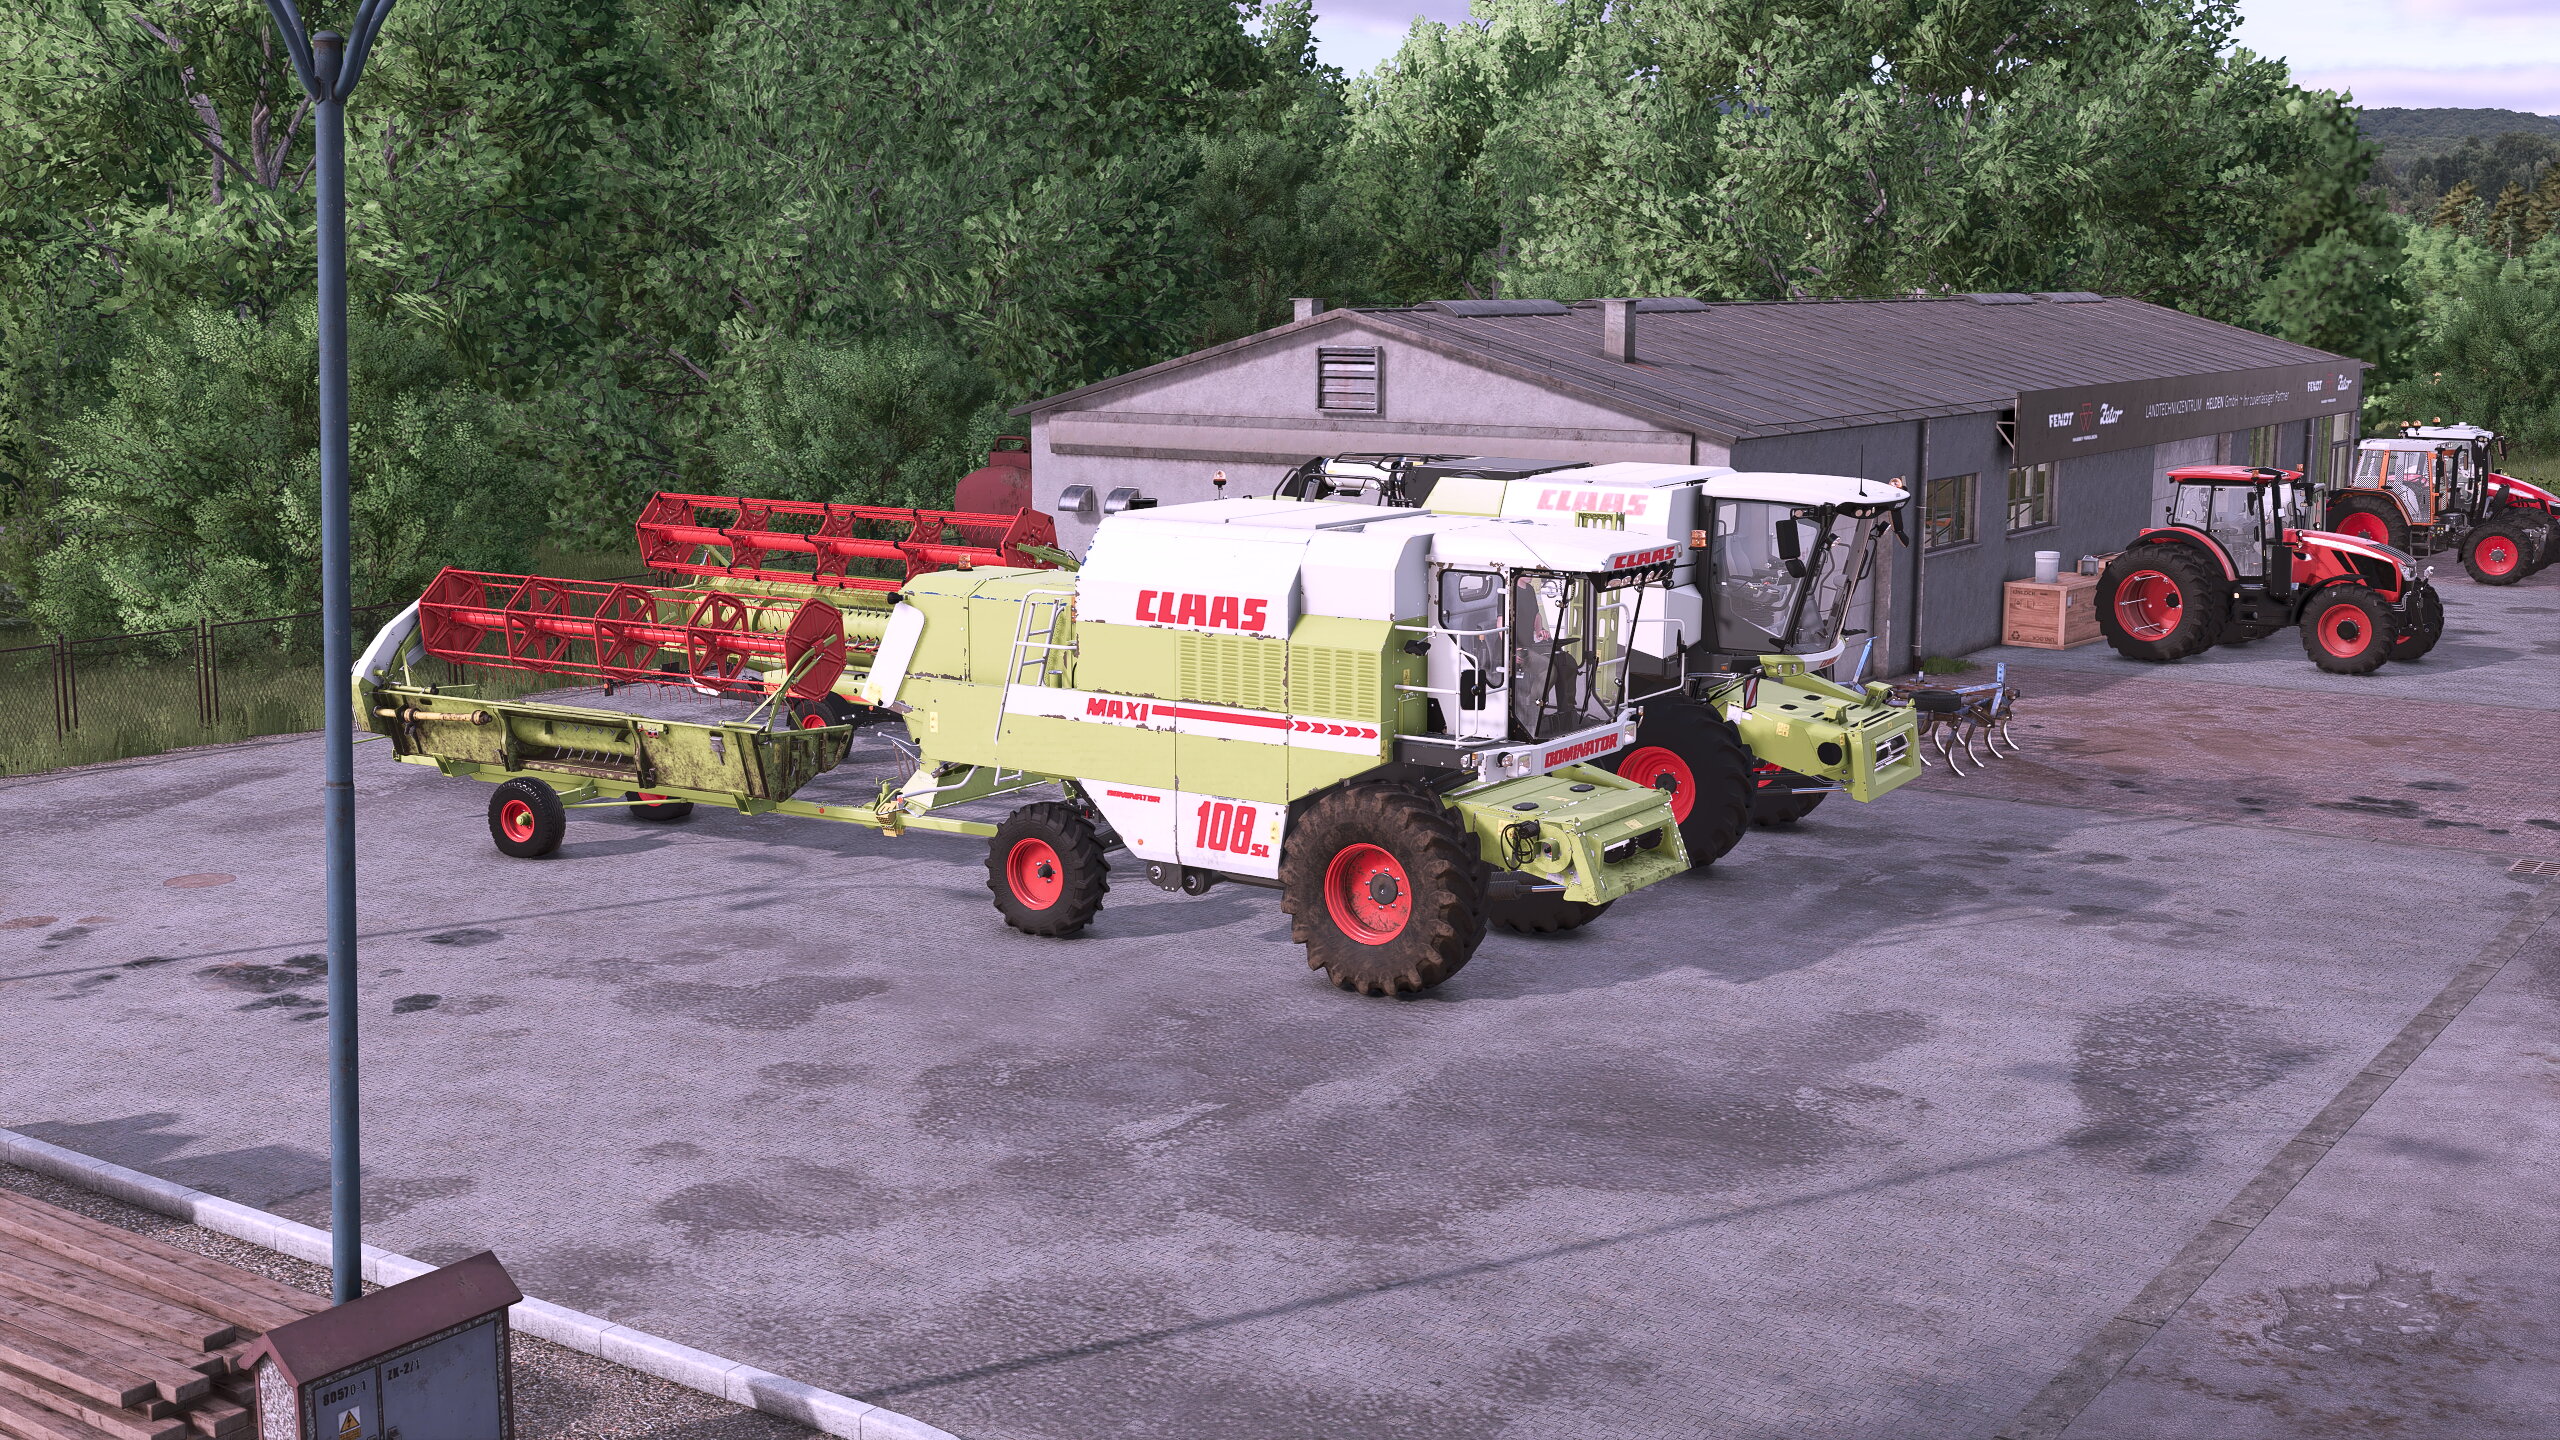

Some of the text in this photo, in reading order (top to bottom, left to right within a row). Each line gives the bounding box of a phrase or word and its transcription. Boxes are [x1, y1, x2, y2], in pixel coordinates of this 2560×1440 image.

[2100, 403, 2124, 425] Zetor
[2206, 396, 2224, 410] HELDEN
[2224, 394, 2239, 407] GmbH
[2049, 412, 2074, 428] FENDT
[1537, 489, 1648, 516] CLAAS
[1614, 546, 1675, 569] CLAAS
[1136, 590, 1268, 632] CLAAS
[1086, 697, 1149, 721] MAXI
[1544, 733, 1618, 768] DOMINATOR
[1107, 790, 1160, 803] DOMINATOR
[1196, 801, 1270, 858] 108 SL
[323, 1380, 366, 1407] 80570-1
